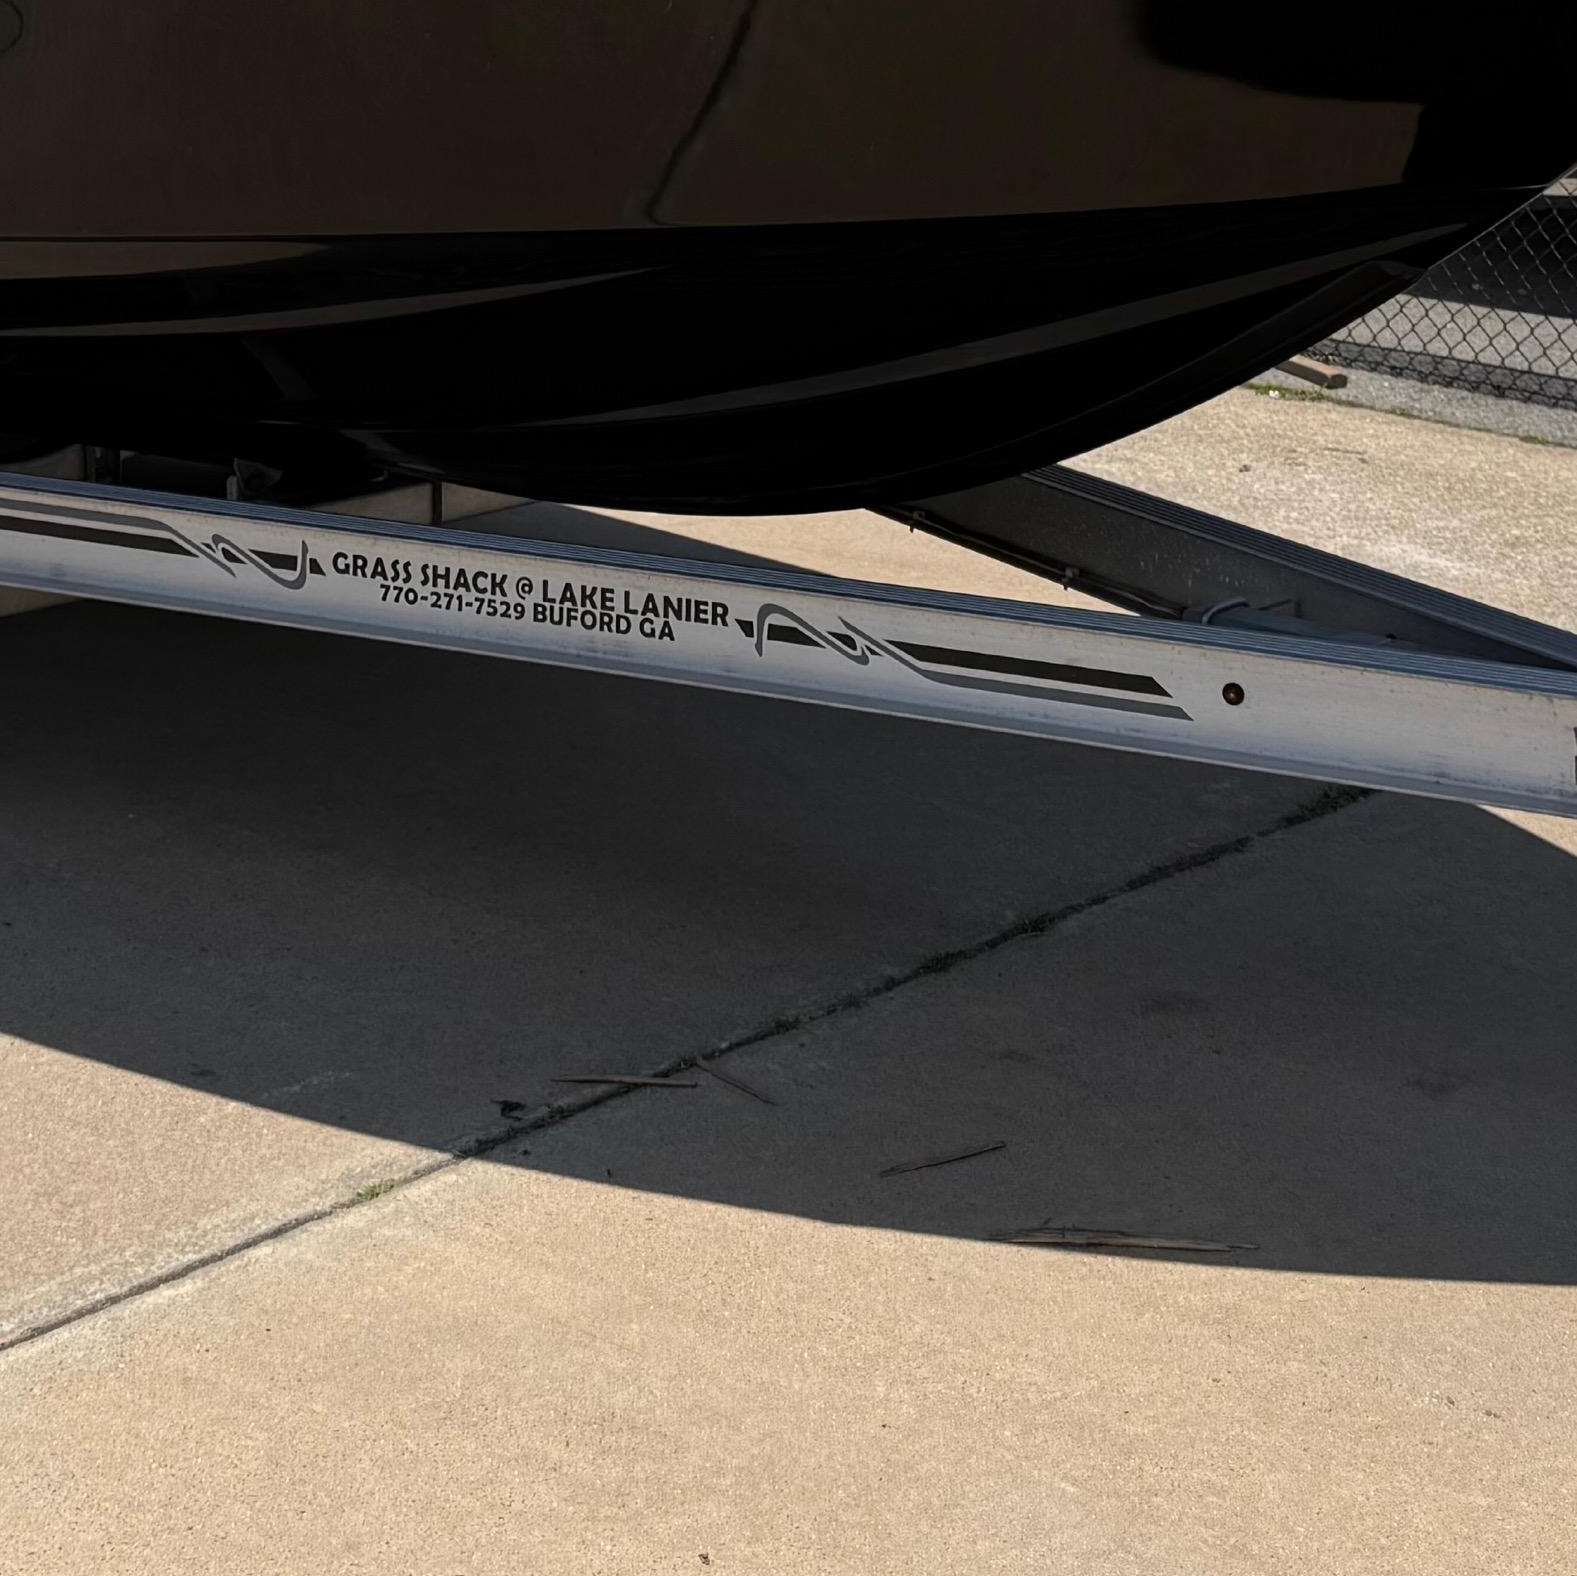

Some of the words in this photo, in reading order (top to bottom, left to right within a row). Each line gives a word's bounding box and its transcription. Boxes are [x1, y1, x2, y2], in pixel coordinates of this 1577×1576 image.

[332, 551, 413, 584] GRASS
[420, 563, 508, 598] SHACK
[515, 576, 534, 601] @
[542, 579, 616, 612] LAKE
[623, 590, 729, 628] LANIER
[379, 583, 526, 621] 770-271-7529
[532, 602, 632, 635] BUFORD
[639, 617, 676, 642] GA
